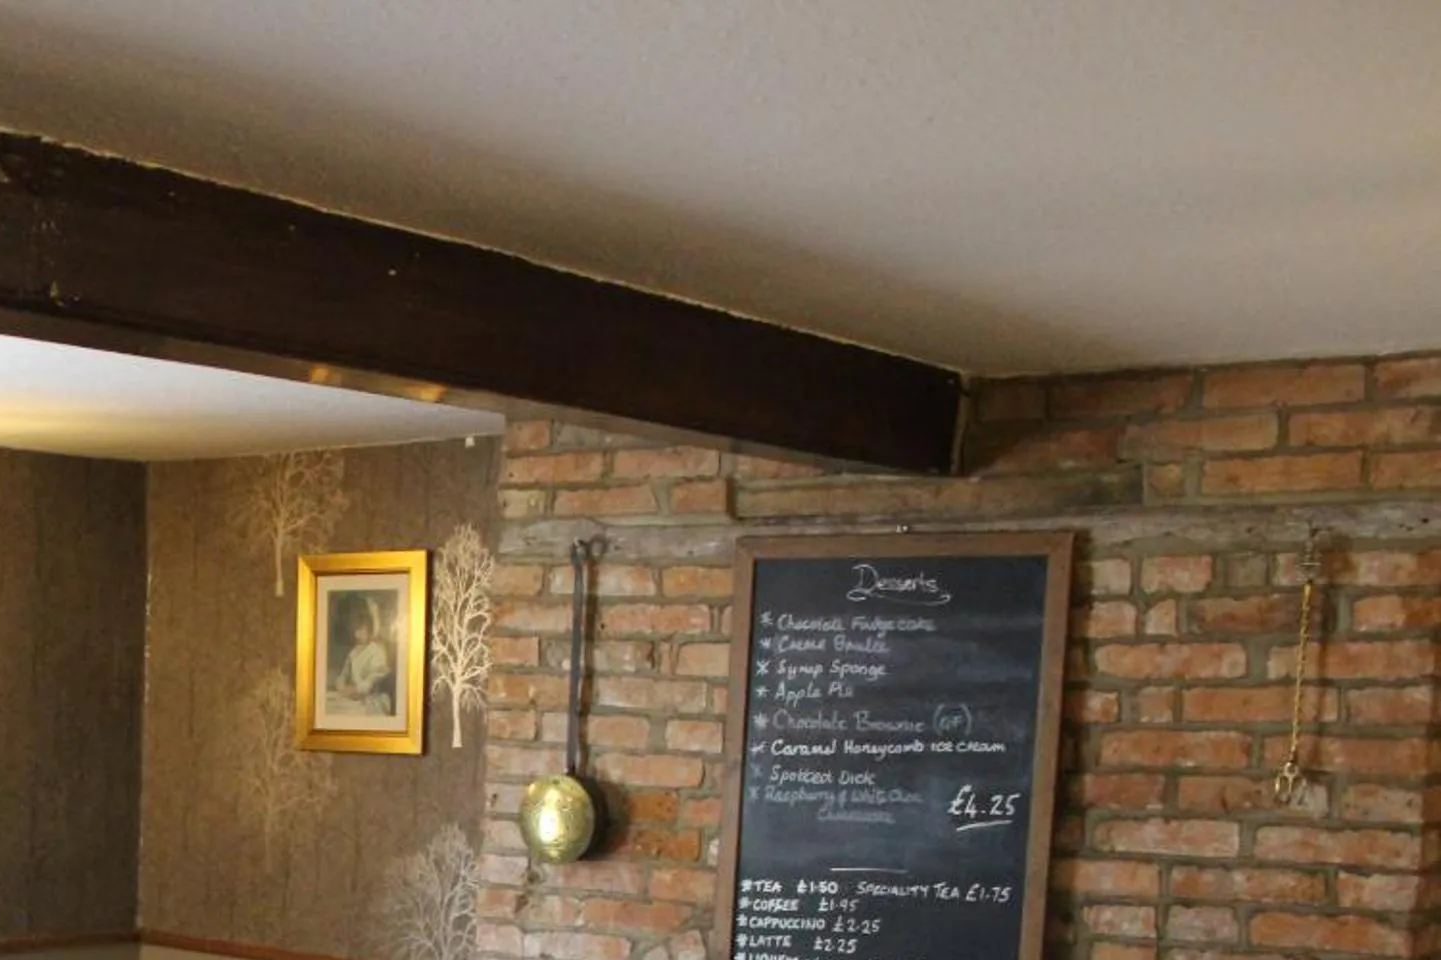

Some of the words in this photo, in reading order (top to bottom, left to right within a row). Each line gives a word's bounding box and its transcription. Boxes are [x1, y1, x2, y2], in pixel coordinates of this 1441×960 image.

[846, 563, 951, 606] Desserts
[776, 660, 823, 680] Syrup
[829, 658, 888, 681] Sponge
[774, 685, 823, 705] Apple
[772, 708, 848, 731] Chocolate
[854, 710, 926, 733] Brownie
[770, 738, 837, 757] Caramel
[843, 740, 925, 761] Honeycomb
[770, 765, 833, 784] Spotted
[838, 768, 876, 786] Dick
[753, 879, 782, 894] TEA
[933, 883, 960, 899] TEA
[752, 897, 800, 912] COFFEE
[748, 915, 826, 930] CAPPUCCINO
[748, 935, 792, 949] LATTE
